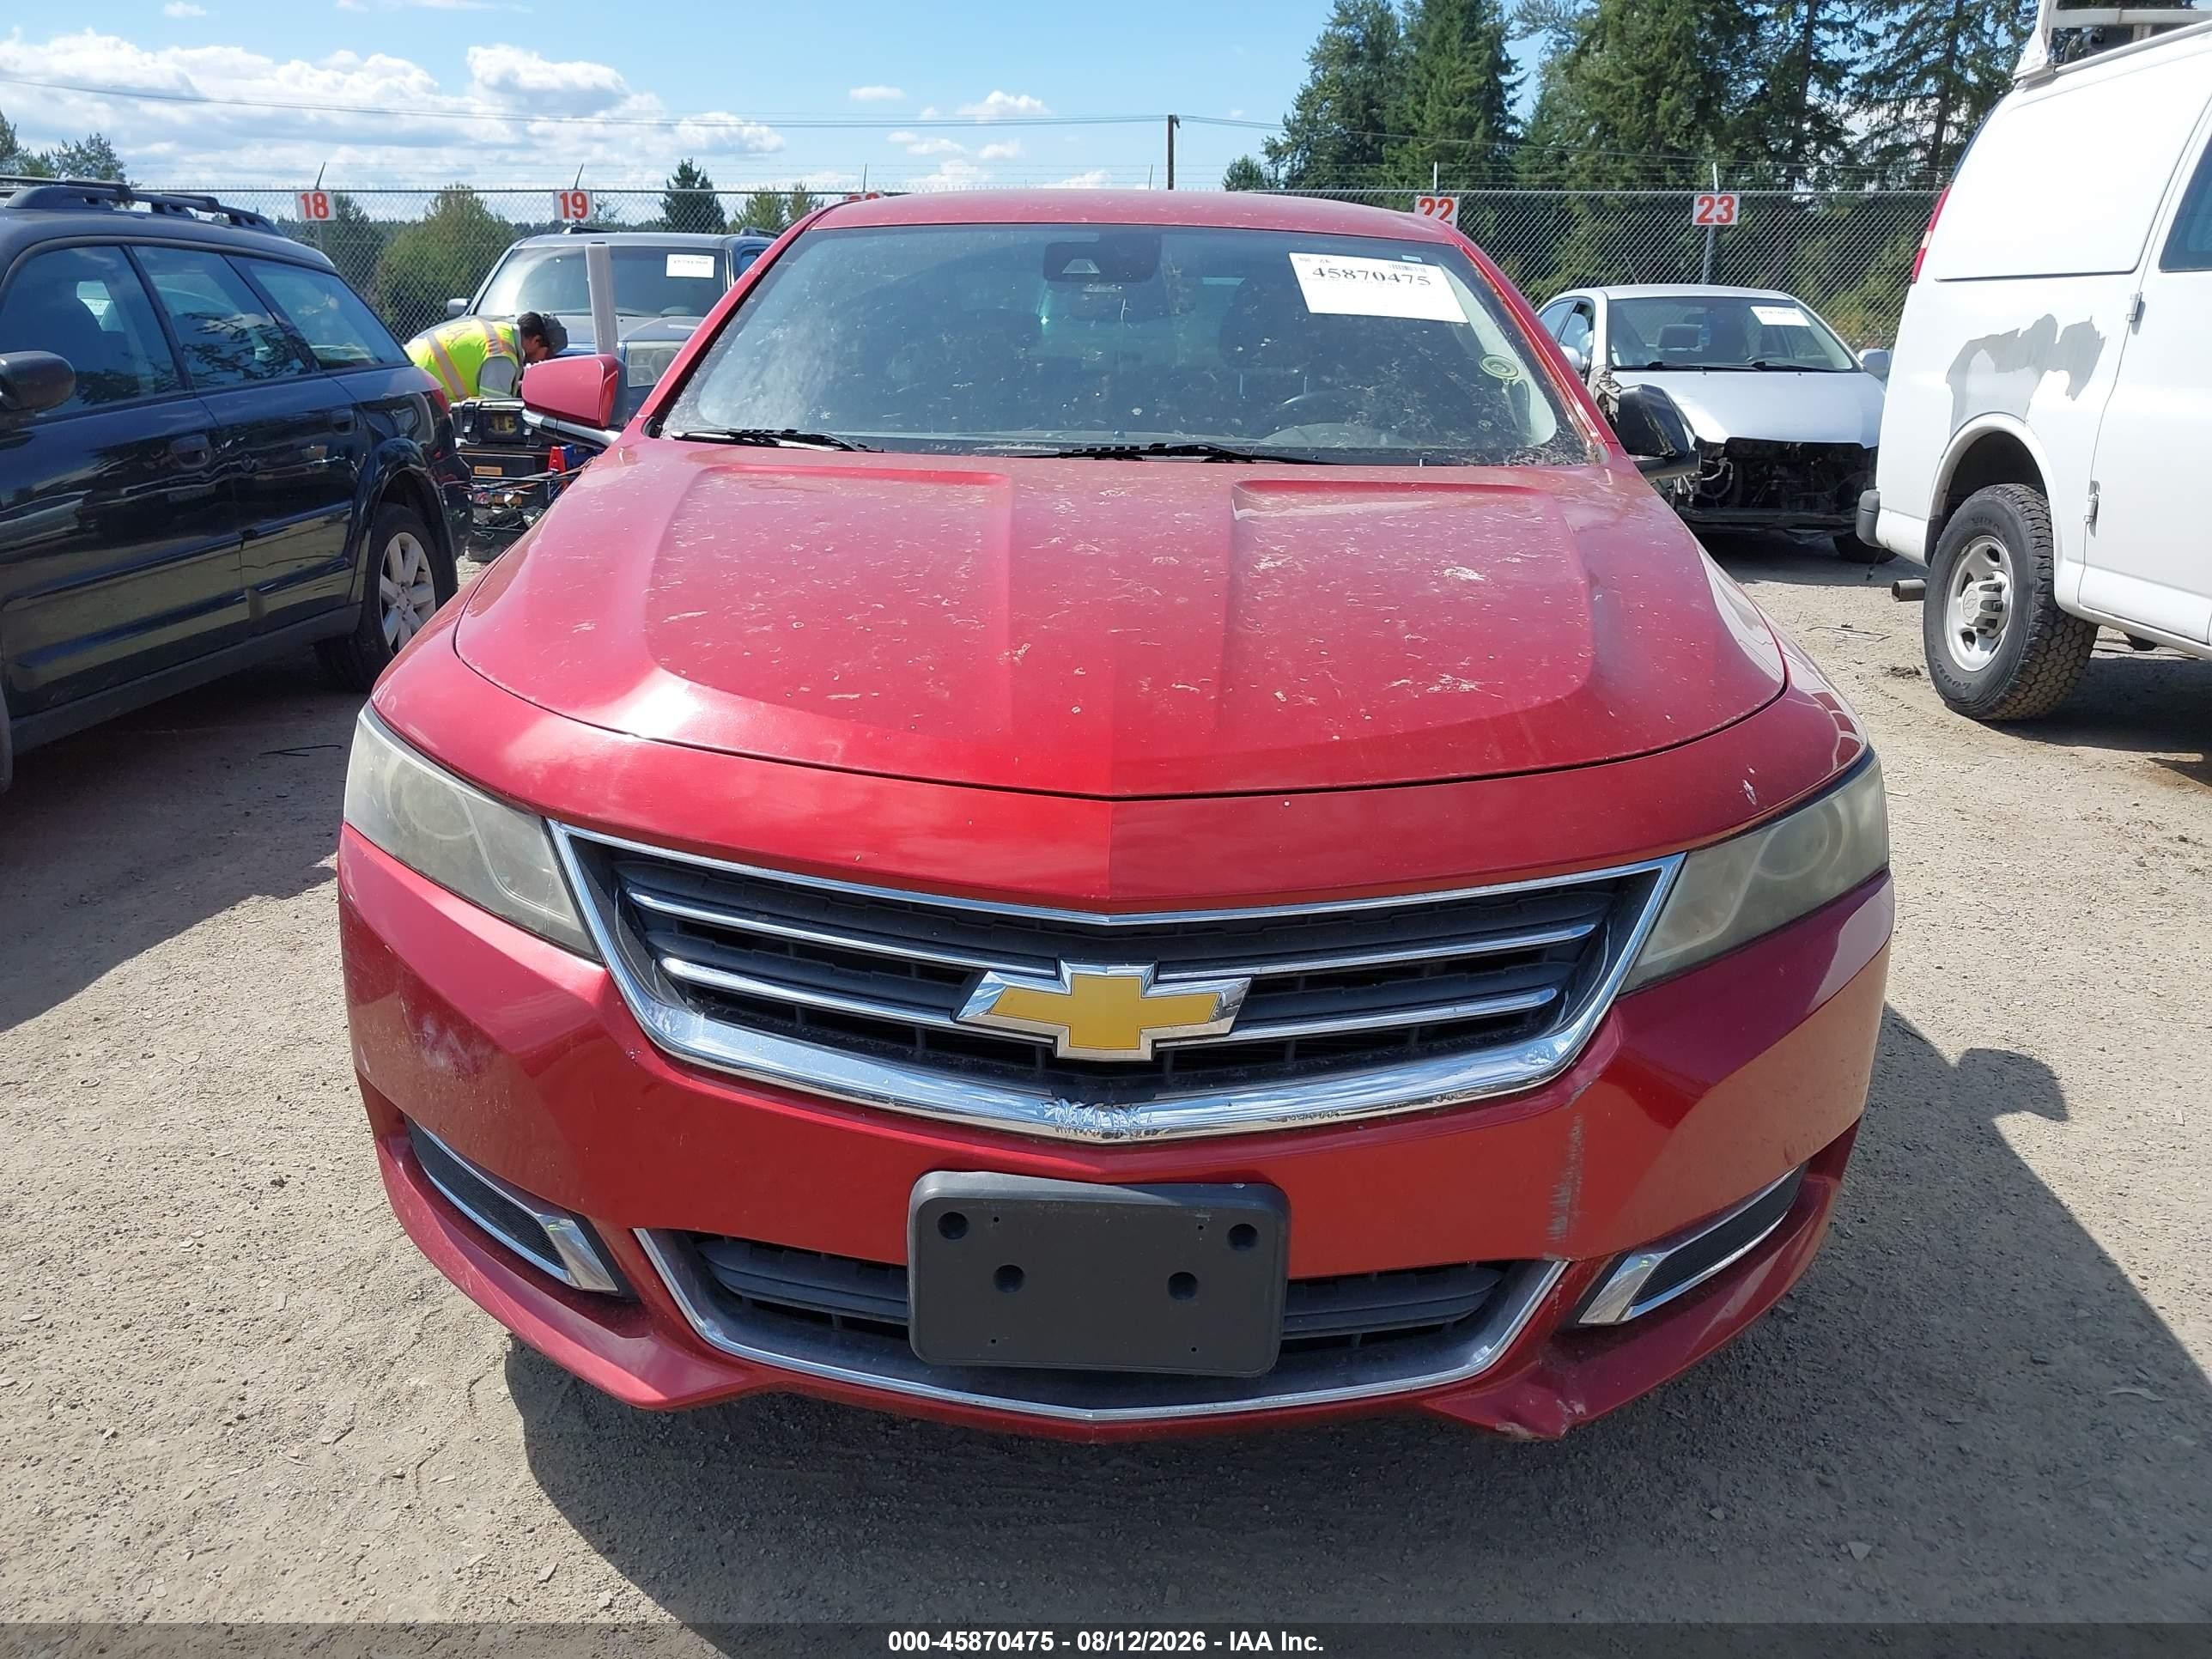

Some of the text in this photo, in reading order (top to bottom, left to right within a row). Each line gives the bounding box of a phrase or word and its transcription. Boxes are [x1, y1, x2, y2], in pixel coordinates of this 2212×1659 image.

[301, 191, 330, 220] 18
[559, 191, 587, 220] 19
[1419, 198, 1454, 225] 22
[1696, 195, 1735, 224] 23
[1312, 267, 1431, 286] 45870475
